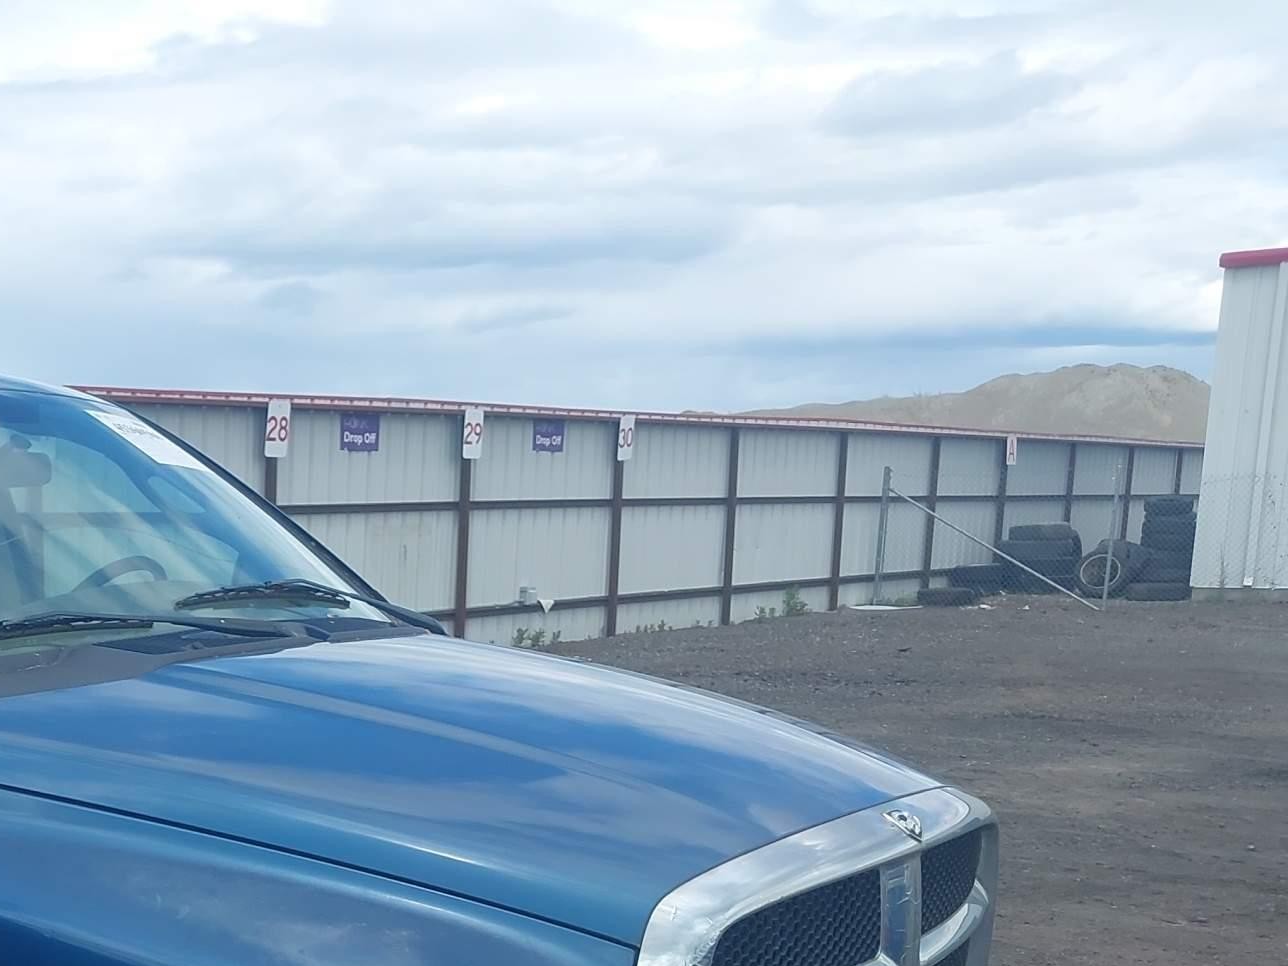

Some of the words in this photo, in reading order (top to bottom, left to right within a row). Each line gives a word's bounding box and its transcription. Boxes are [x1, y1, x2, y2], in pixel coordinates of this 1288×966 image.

[266, 415, 289, 442] 28
[343, 431, 363, 446] Drop
[364, 432, 377, 444] Off
[463, 422, 483, 445] 29
[618, 427, 633, 448] 30
